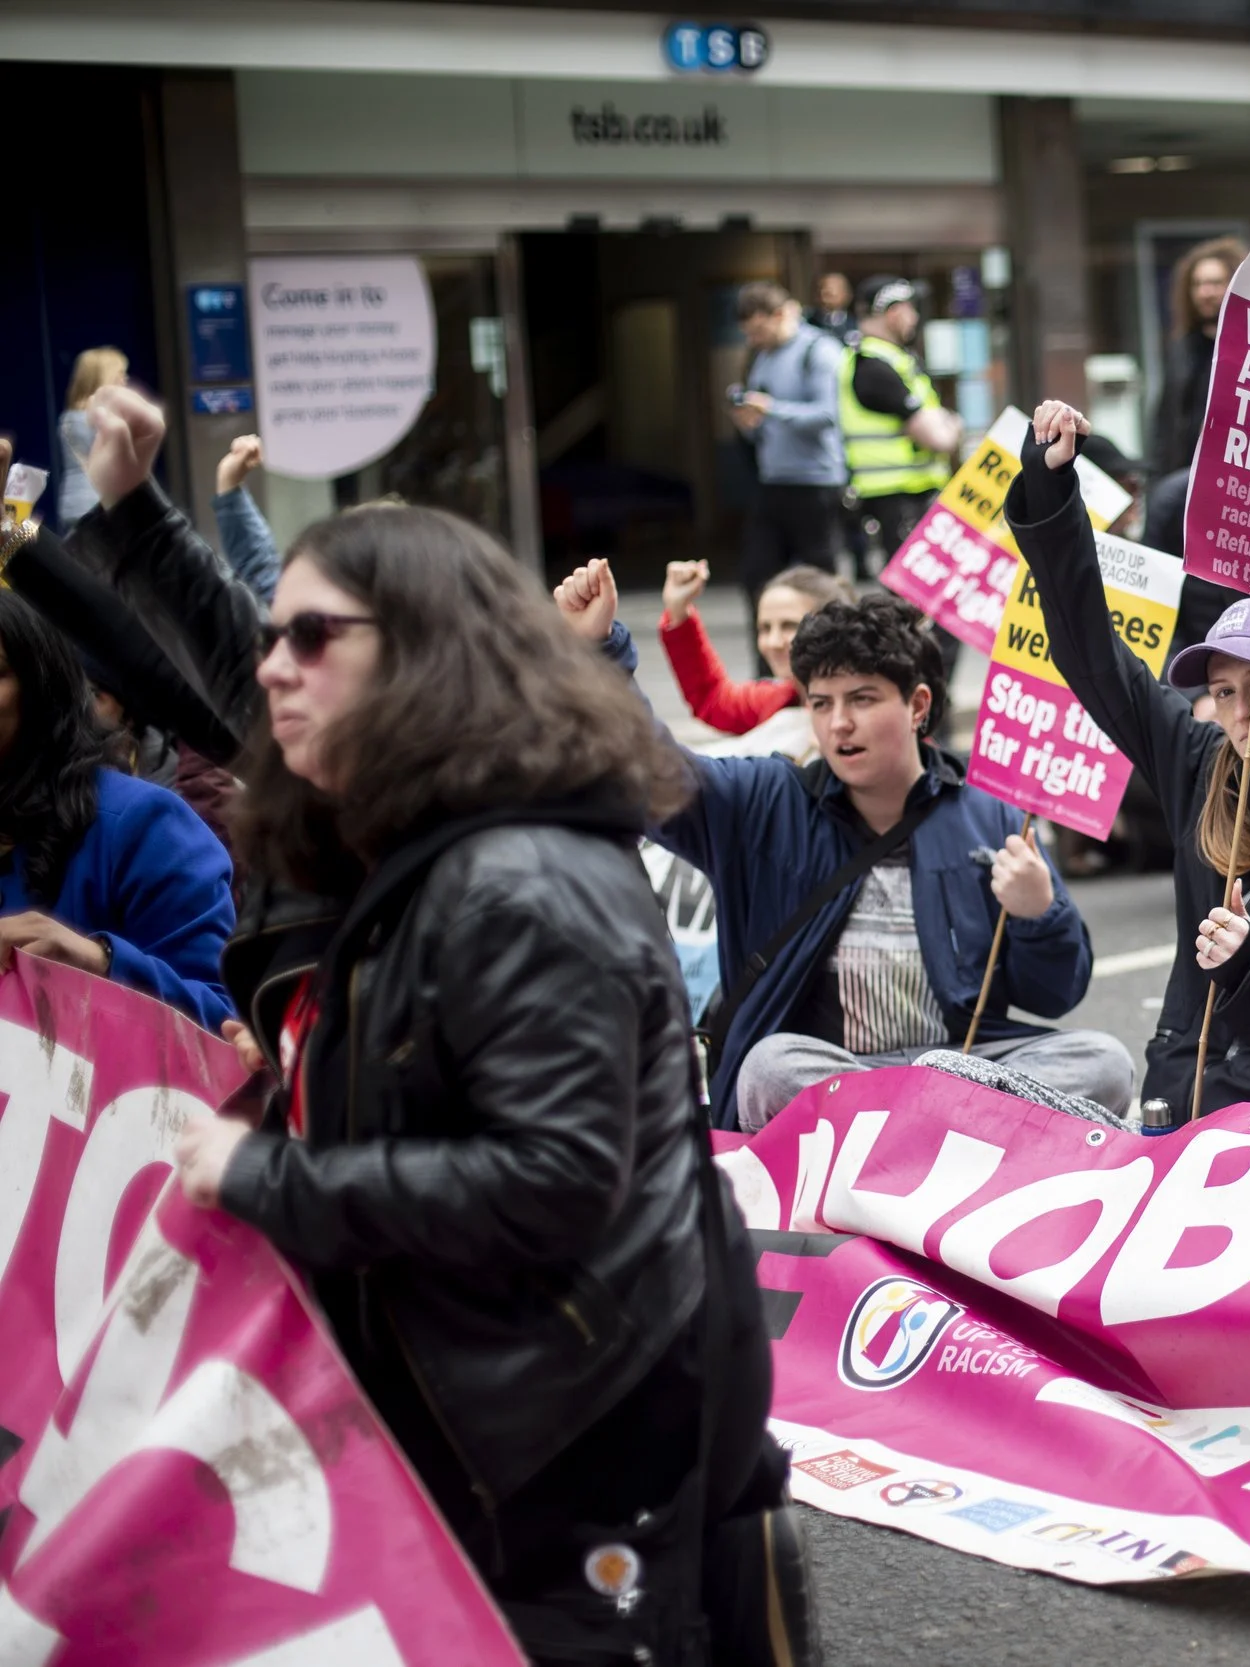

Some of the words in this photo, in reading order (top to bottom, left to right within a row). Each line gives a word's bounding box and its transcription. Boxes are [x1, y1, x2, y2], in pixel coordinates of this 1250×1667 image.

[674, 27, 768, 67] TSB
[570, 102, 730, 146] tsb.co.uk
[923, 511, 990, 576] Stop
[1128, 552, 1146, 570] UP
[901, 540, 950, 586] far
[1212, 557, 1240, 579] not
[987, 672, 1057, 739] Stop
[978, 718, 1021, 768] far
[1019, 741, 1107, 801] right
[952, 1322, 997, 1341] UP
[937, 1345, 1041, 1378] RACISM
[810, 1459, 868, 1484] ACTION
[827, 1455, 882, 1480] POSITIVE
